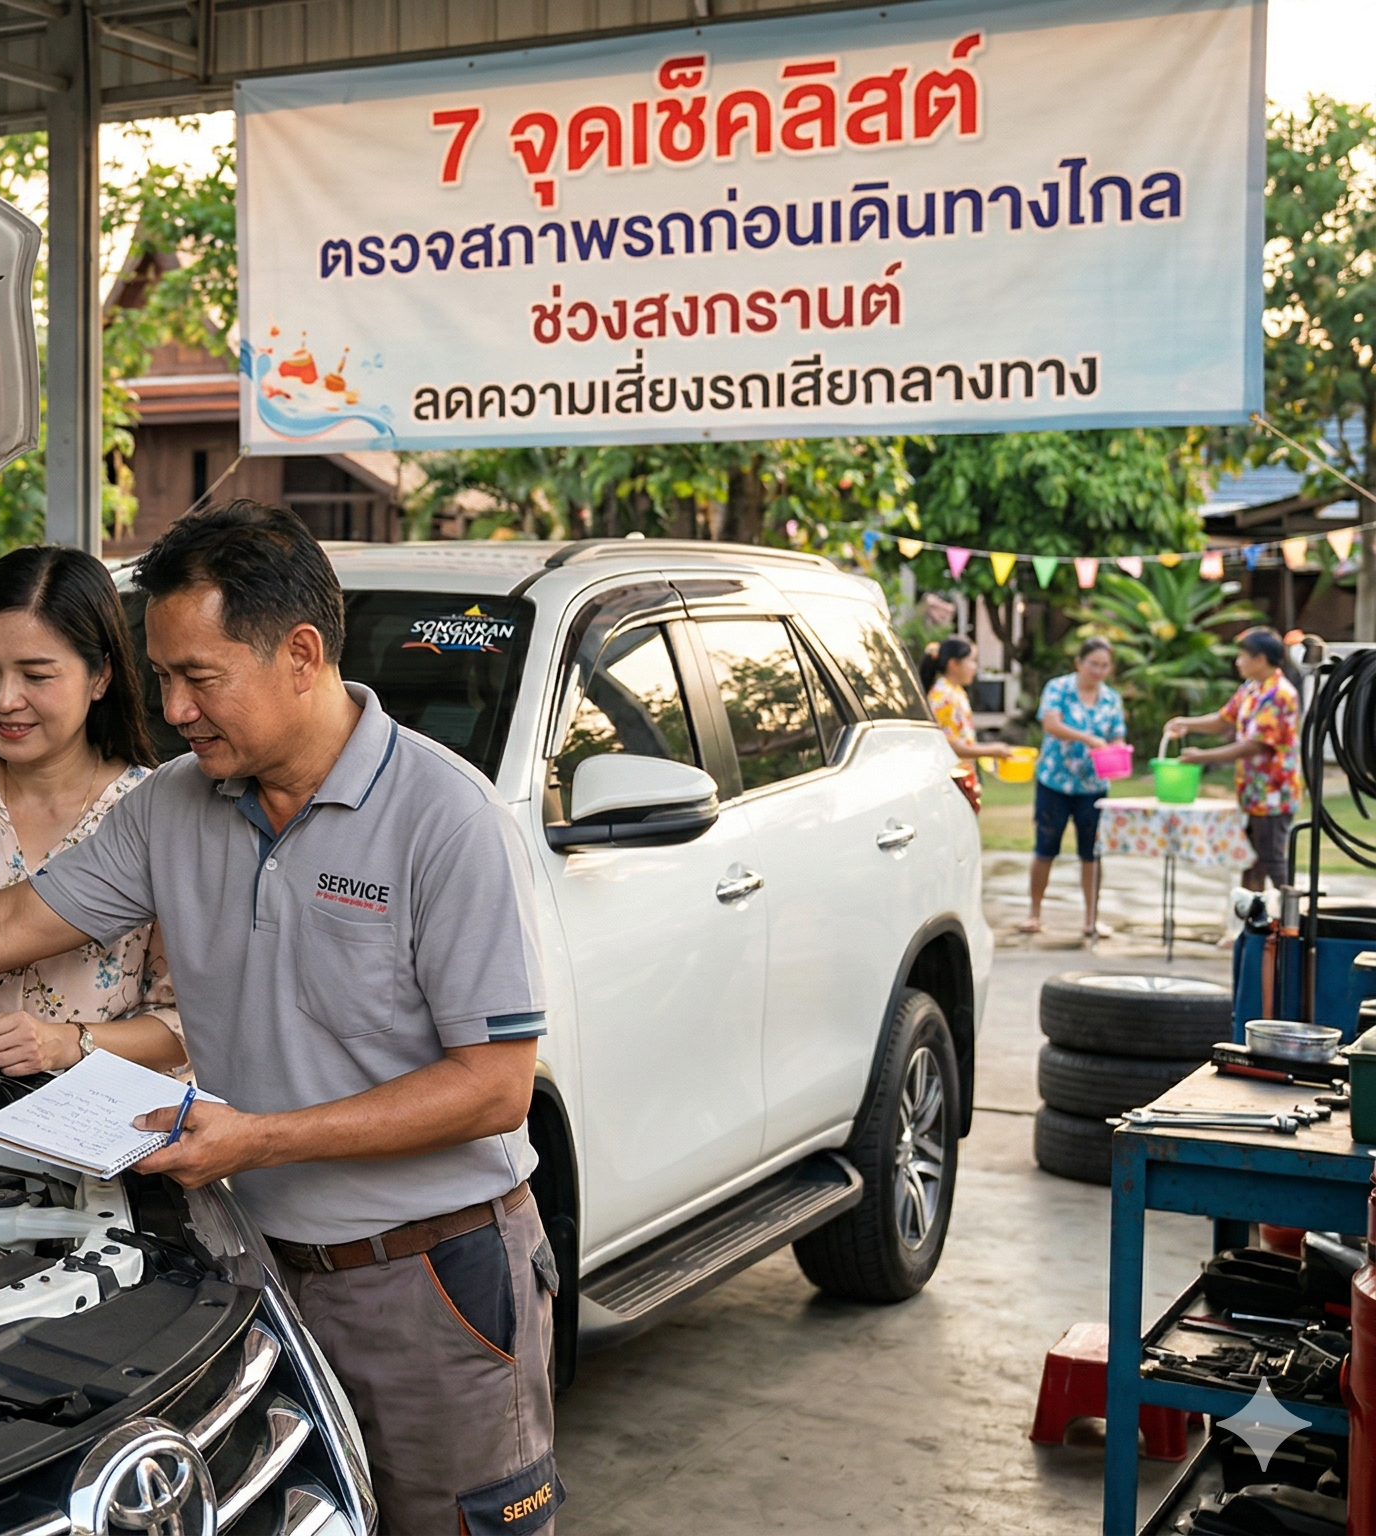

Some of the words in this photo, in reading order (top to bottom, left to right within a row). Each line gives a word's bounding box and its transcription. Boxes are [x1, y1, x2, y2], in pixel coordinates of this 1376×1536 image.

[432, 108, 480, 184] 7
[508, 33, 981, 208] จุดเช็คลิสต์
[320, 157, 1182, 279] ตรวจสภาพรถก่อนเดินทางไกล
[531, 261, 902, 344] ช่วงสงกรานต์
[413, 348, 1097, 421] ลดความเสี่ยงรถเสียกลางทาง
[410, 620, 515, 639] SONGKRAN
[421, 632, 495, 647] FESTIVAL
[317, 872, 390, 904] SERVICE
[503, 1482, 553, 1523] SERVICE
